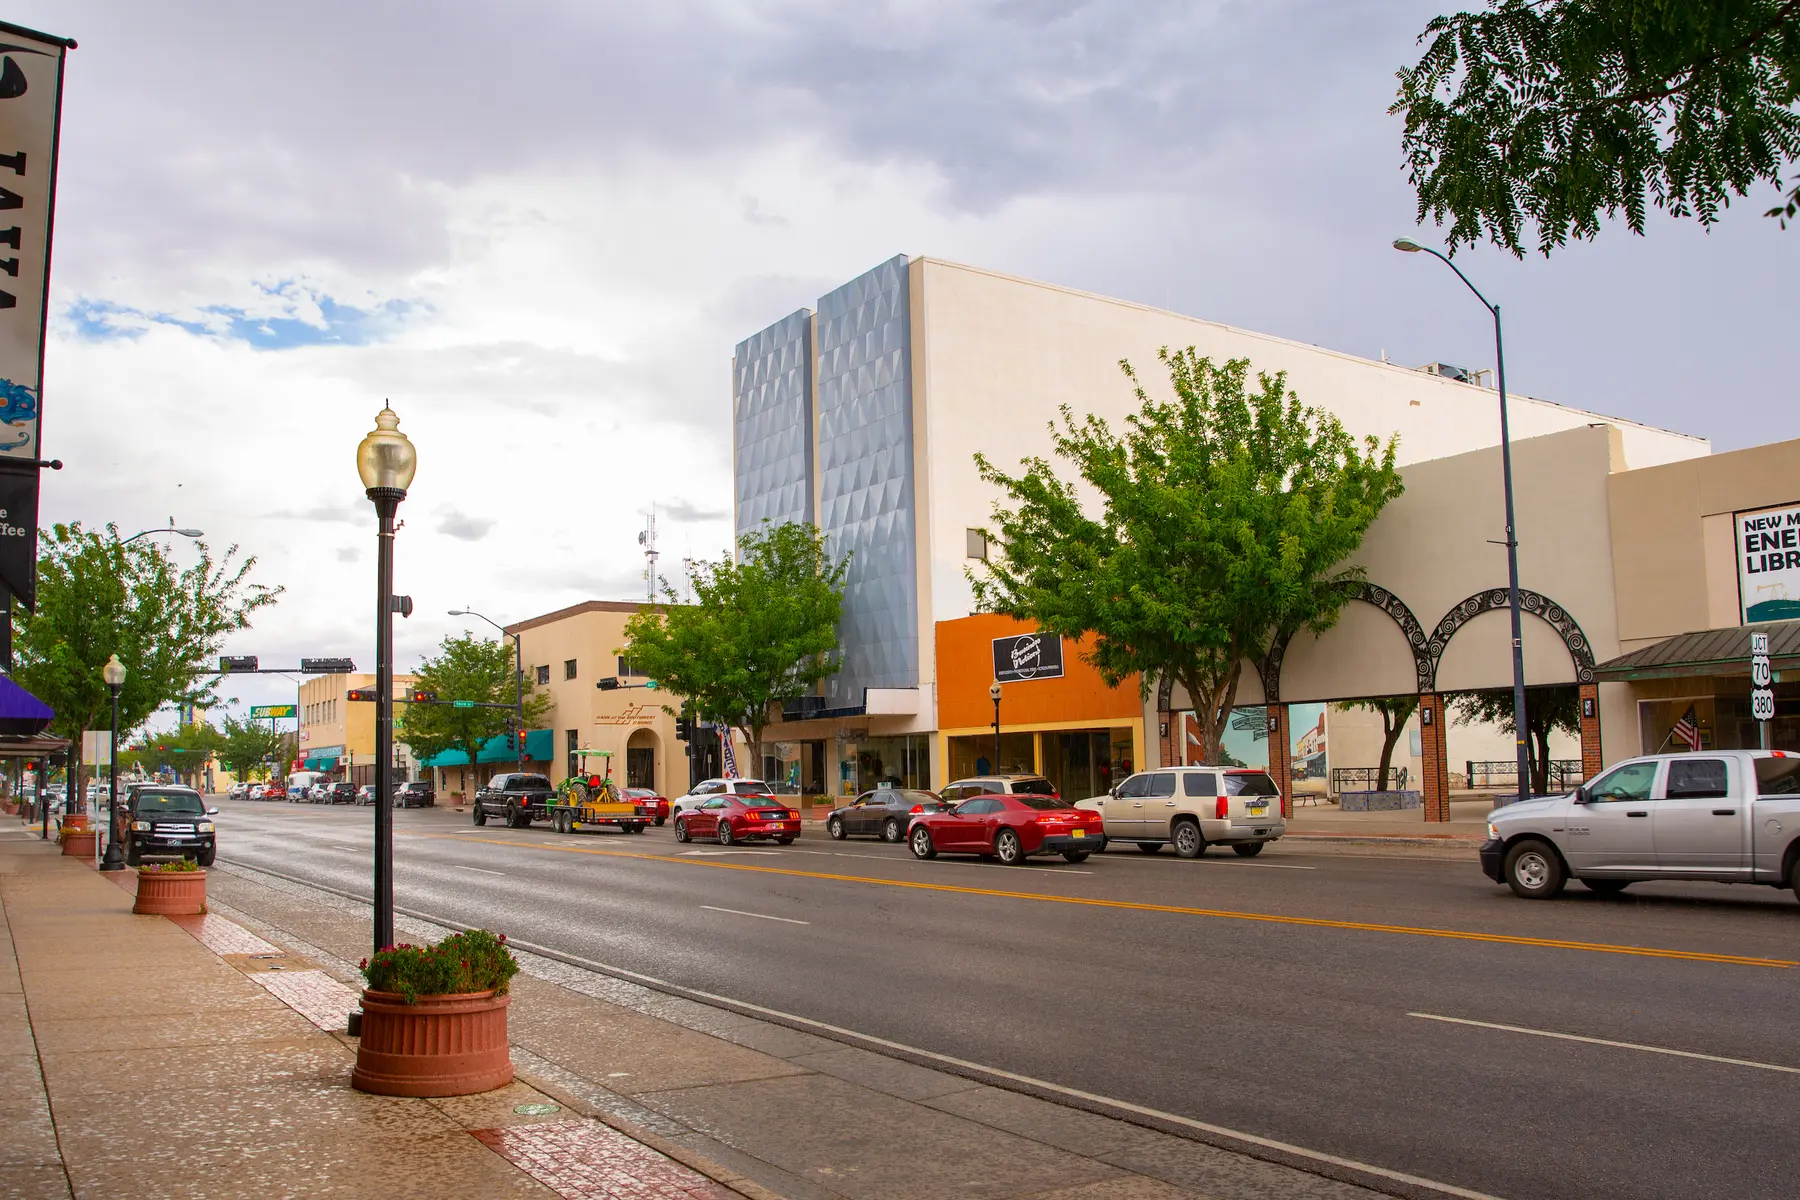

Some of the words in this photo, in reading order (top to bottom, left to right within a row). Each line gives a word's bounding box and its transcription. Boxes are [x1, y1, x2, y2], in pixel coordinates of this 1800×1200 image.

[1744, 515, 1782, 532] NEW
[1745, 527, 1800, 553] ENE
[1746, 550, 1800, 574] LIBR
[1011, 638, 1041, 659] Business
[1754, 637, 1767, 650] JCT
[1013, 649, 1041, 669] Notions
[1754, 662, 1769, 680] 70
[252, 705, 292, 718] SUBWAY
[1754, 696, 1772, 714] 380
